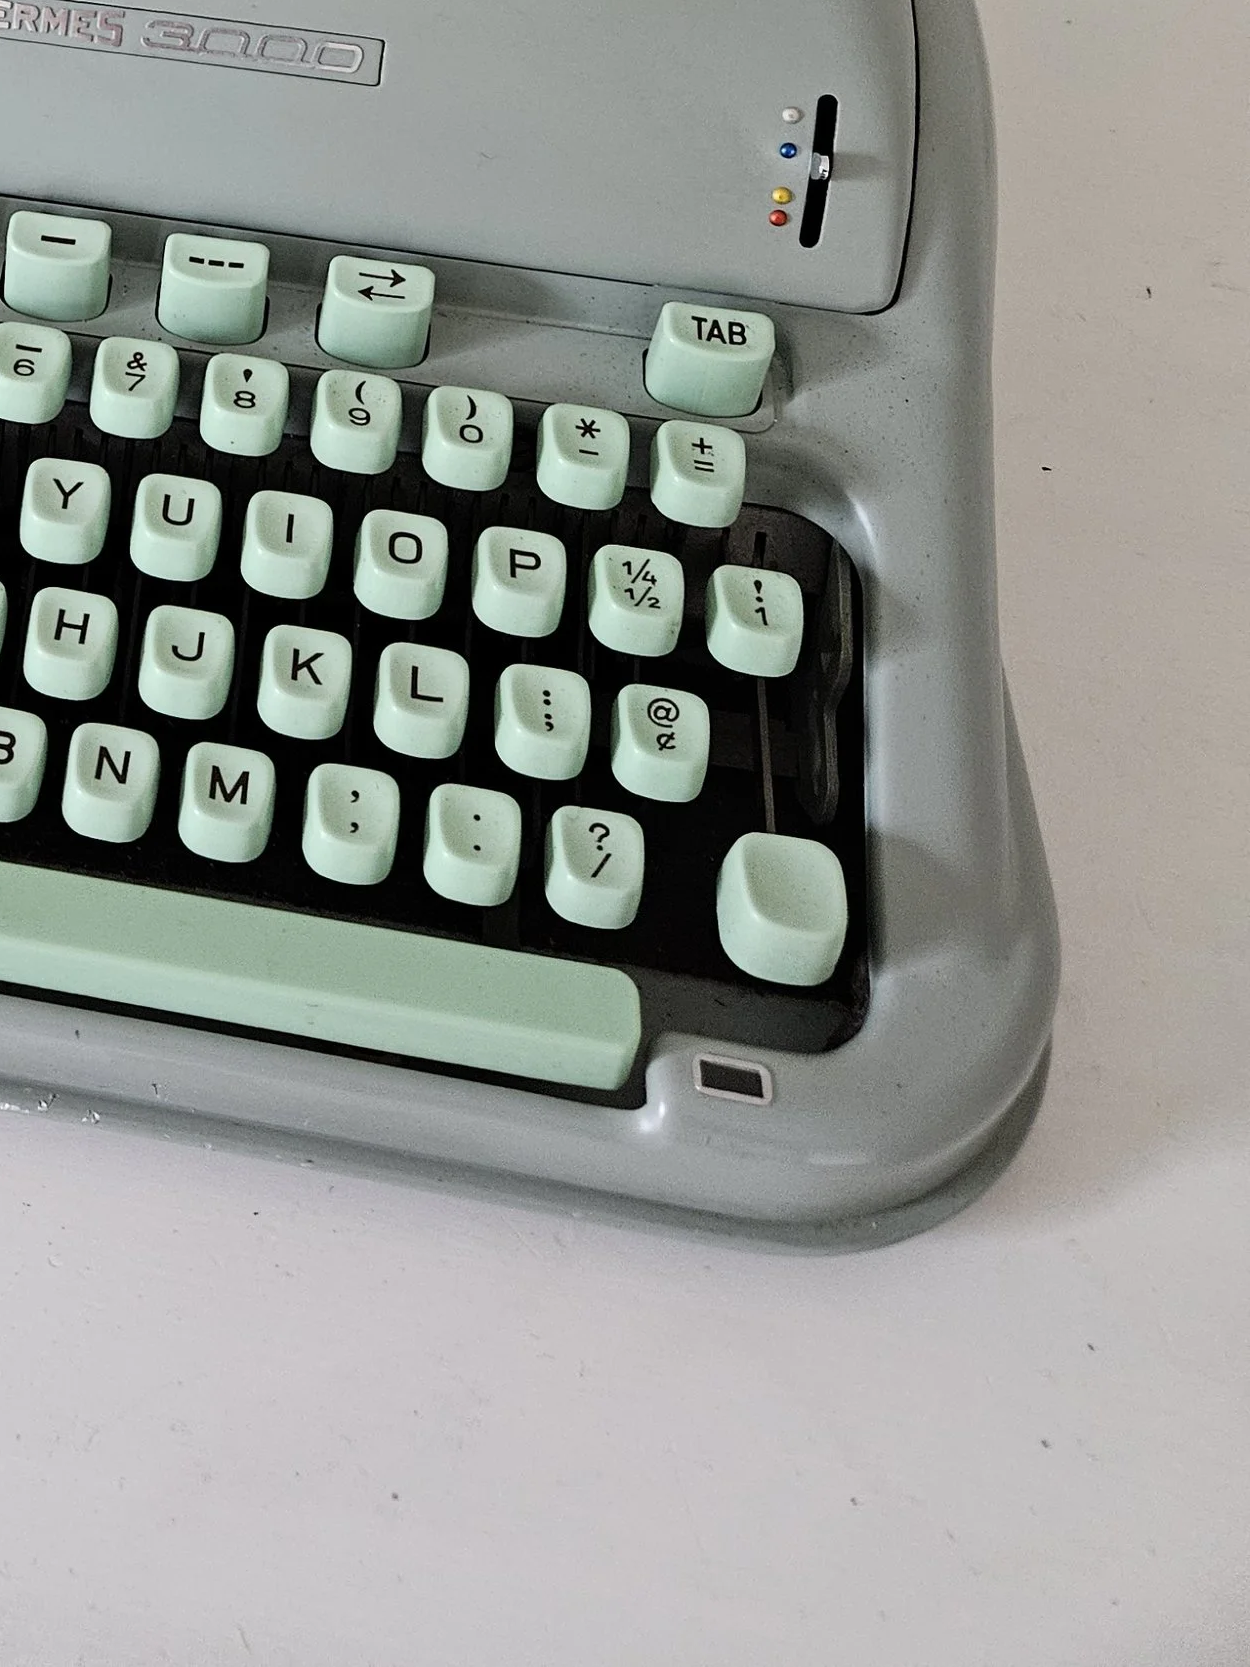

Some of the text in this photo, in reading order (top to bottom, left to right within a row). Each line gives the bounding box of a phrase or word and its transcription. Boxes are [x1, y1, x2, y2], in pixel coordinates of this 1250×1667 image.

[140, 19, 365, 74] 3000
[690, 315, 748, 346] TAB
[12, 358, 35, 377] 6
[126, 351, 148, 372] &
[124, 371, 146, 392] 7
[232, 390, 256, 409] 8
[347, 407, 371, 427] 9
[691, 437, 713, 455] +
[52, 478, 84, 510] Y
[161, 493, 195, 527] U
[285, 513, 295, 544] I
[388, 531, 423, 565] O
[509, 548, 542, 579] P
[53, 608, 91, 645] H
[171, 631, 206, 662] J
[290, 647, 325, 686] K
[410, 665, 444, 703] L
[646, 697, 680, 729] @
[93, 745, 132, 785] N
[208, 764, 250, 805] M
[588, 822, 611, 852] ?
[590, 852, 612, 879] /
